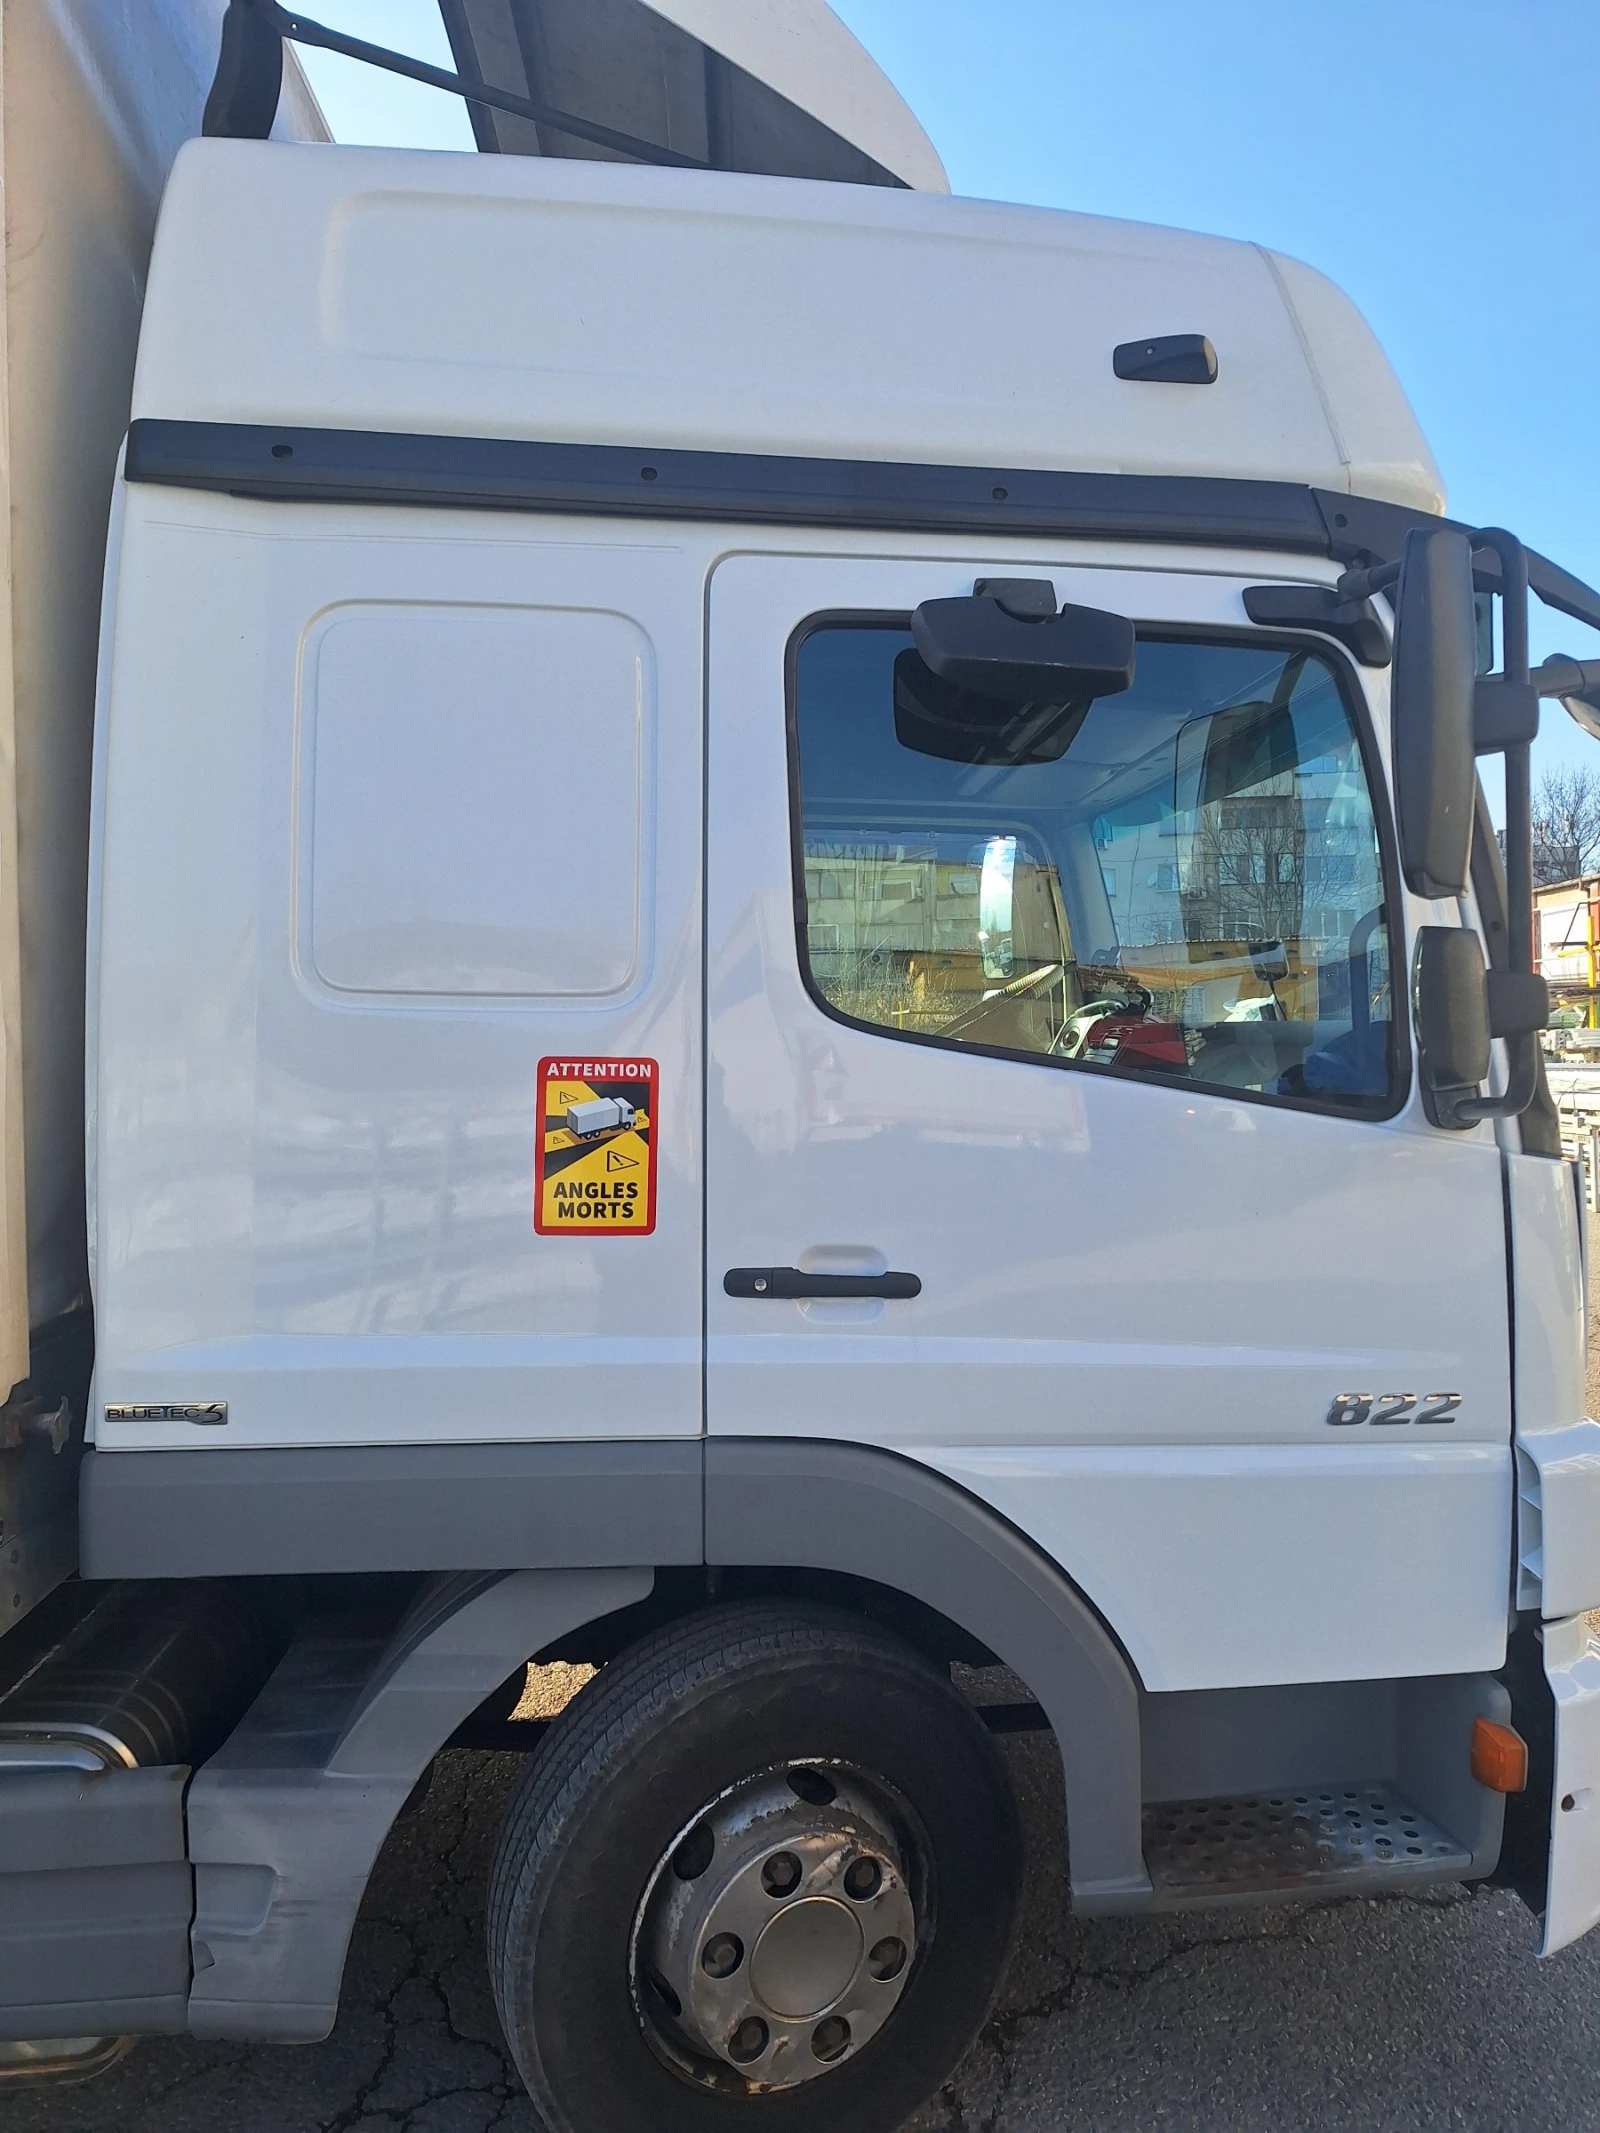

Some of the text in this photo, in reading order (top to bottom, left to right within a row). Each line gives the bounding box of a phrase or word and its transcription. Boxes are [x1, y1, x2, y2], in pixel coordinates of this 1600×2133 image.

[547, 1062, 652, 1077] ATTENTION
[553, 1182, 638, 1199] ANGLES
[557, 1202, 634, 1218] MORTS
[1326, 1392, 1463, 1426] 822
